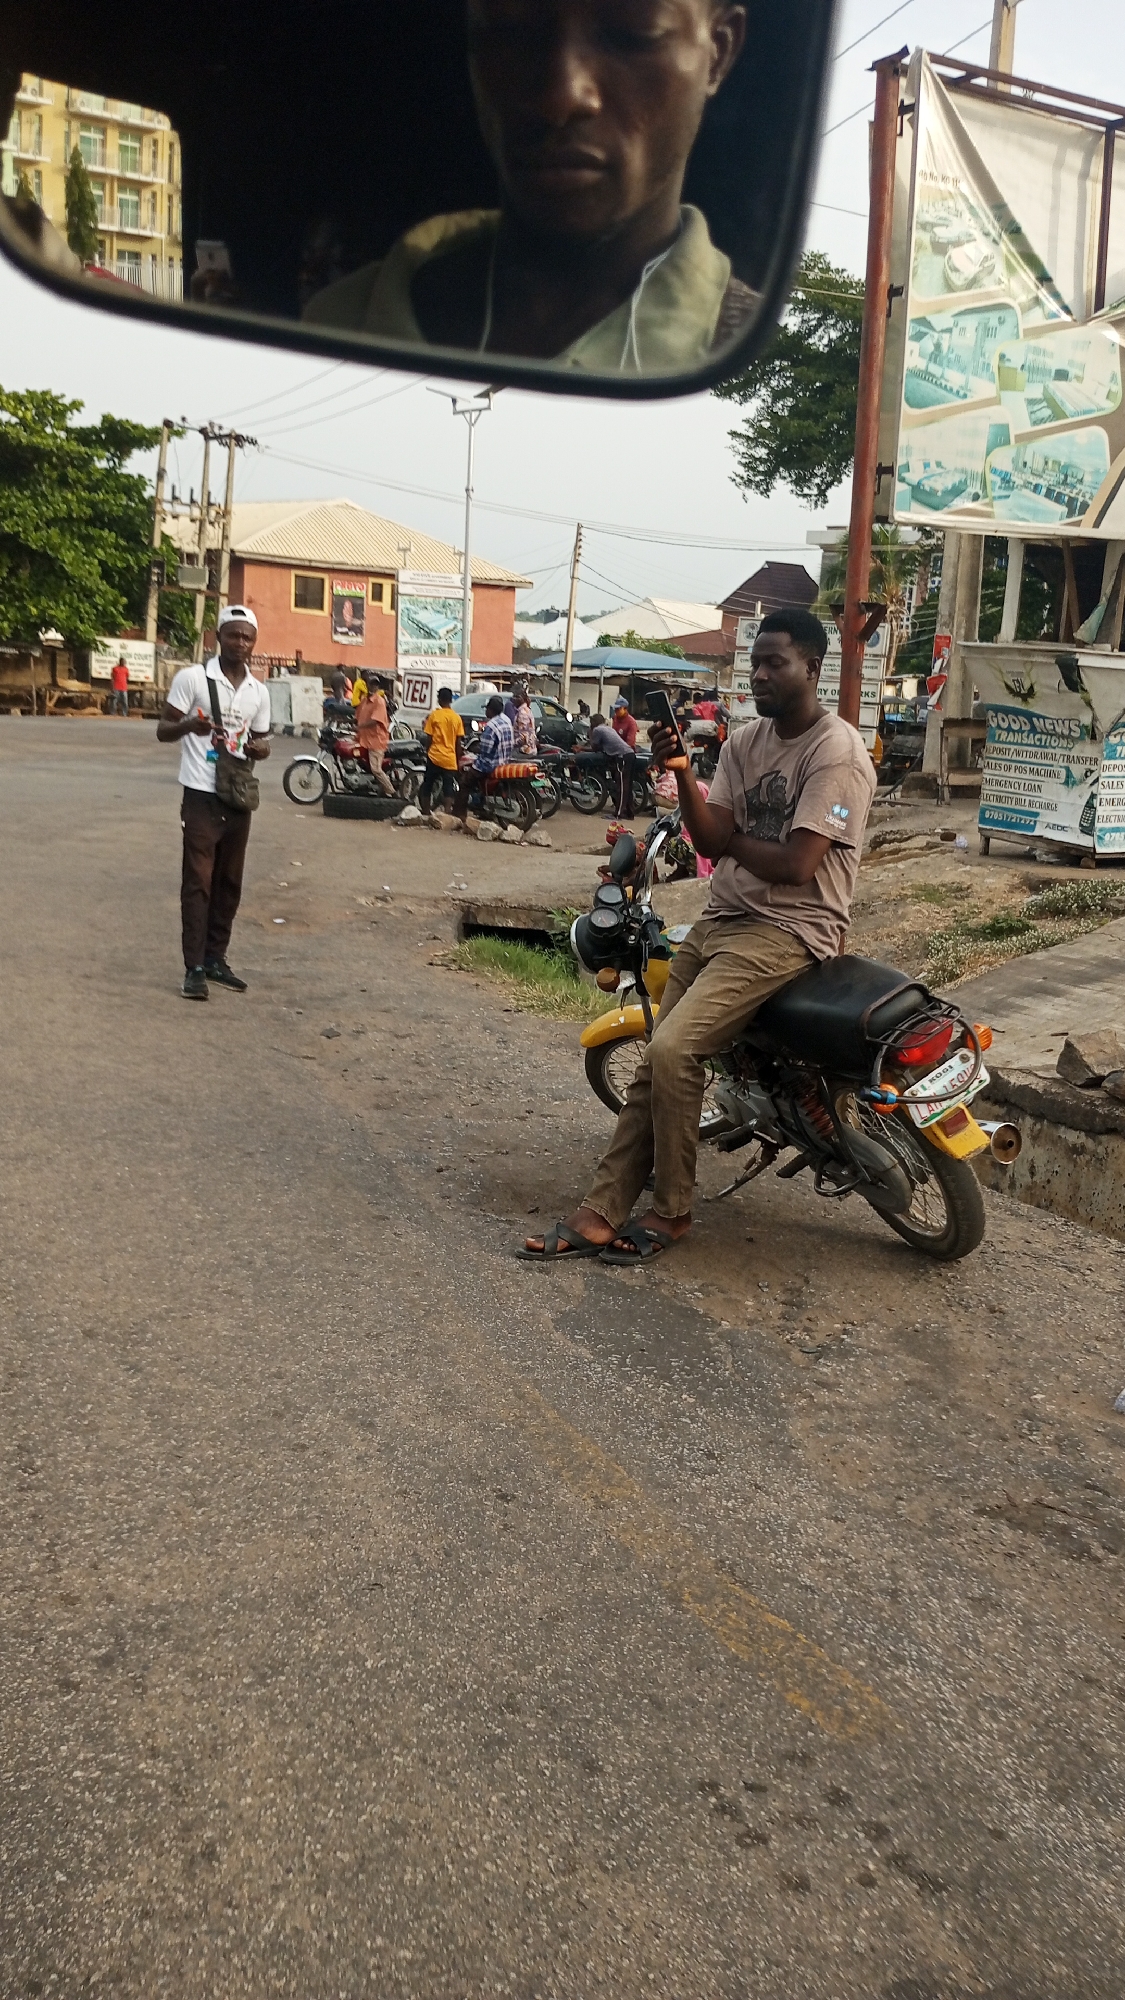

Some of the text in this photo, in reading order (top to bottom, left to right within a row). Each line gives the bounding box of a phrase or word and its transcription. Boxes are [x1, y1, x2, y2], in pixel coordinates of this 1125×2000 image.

[406, 679, 429, 703] TEC
[987, 709, 1081, 738] GOOD NEWS
[994, 729, 1075, 750] TRANSACTIONS
[1003, 763, 1013, 773] OF
[1014, 764, 1028, 775] POS
[1029, 766, 1062, 779] MACHINE
[982, 777, 1043, 794] EMERGENCY LOAN
[1101, 780, 1124, 790] SALES
[1015, 796, 1027, 808] BILL
[1028, 798, 1058, 812] RECHARGE
[928, 1065, 954, 1084] KOGI
